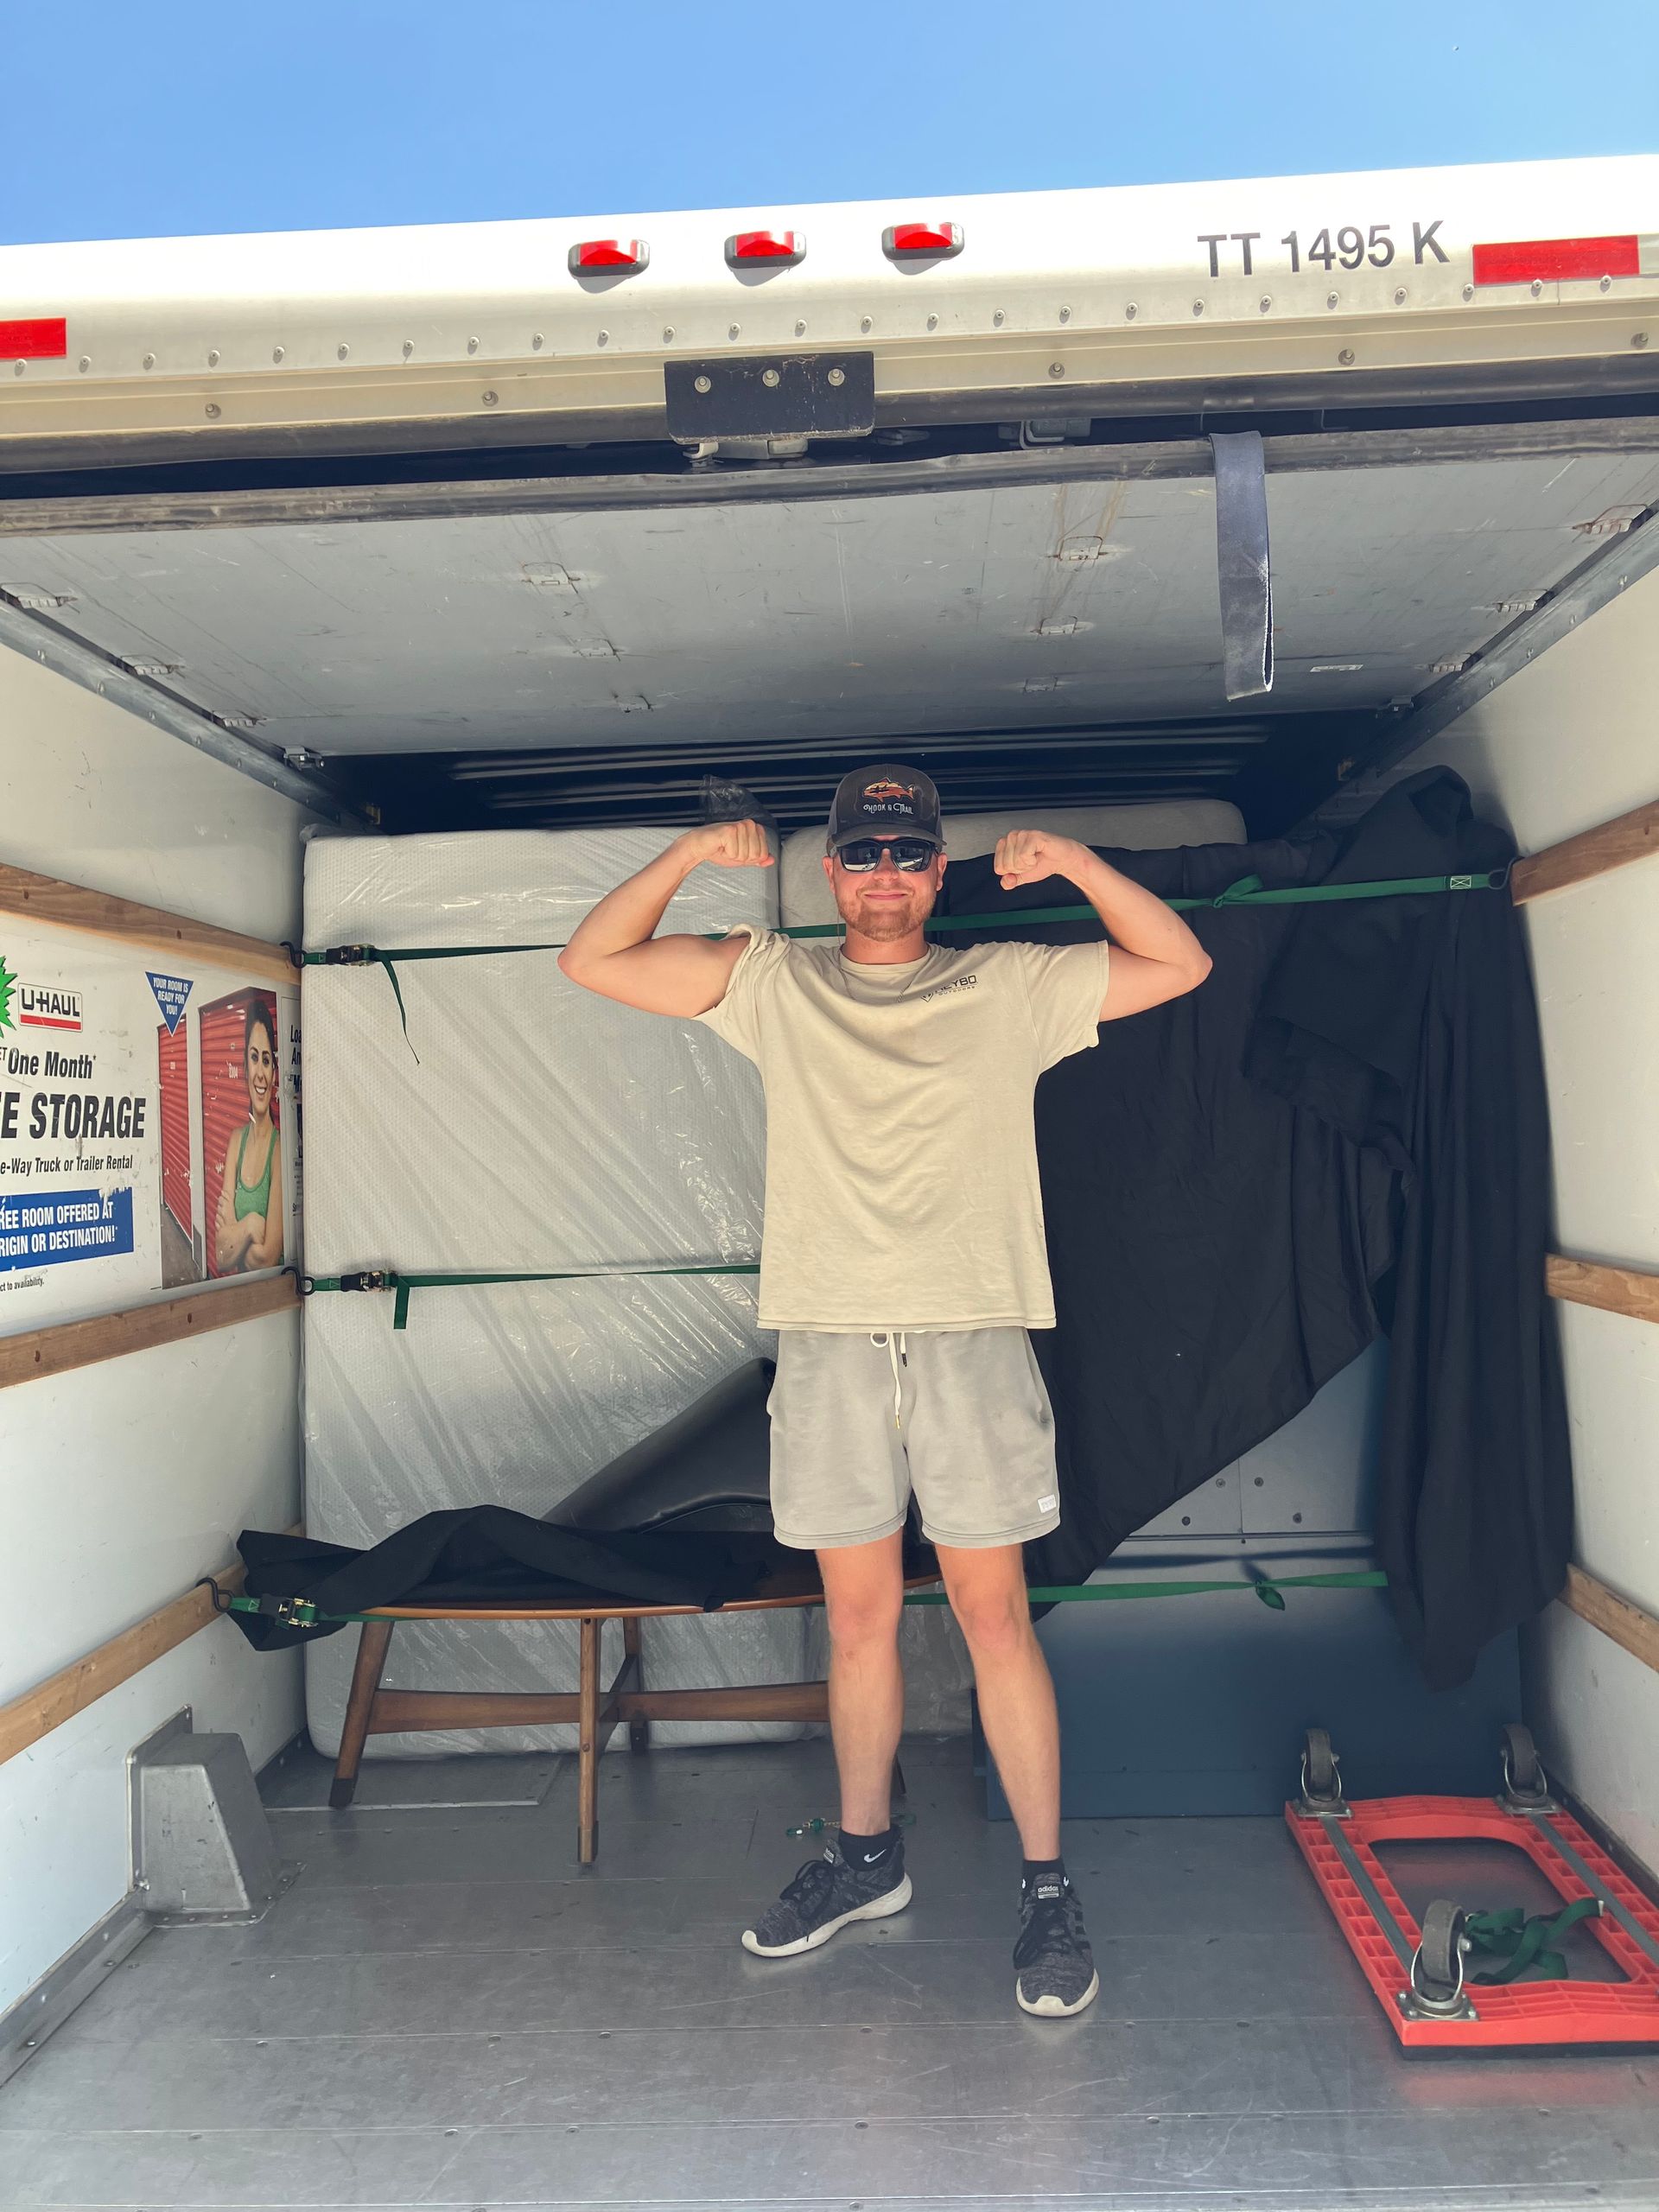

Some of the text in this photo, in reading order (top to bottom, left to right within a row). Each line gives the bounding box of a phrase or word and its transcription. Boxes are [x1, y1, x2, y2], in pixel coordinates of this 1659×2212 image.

[1197, 219, 1451, 278] TT 1495 K
[21, 988, 80, 1017] U-HAUL
[175, 994, 185, 1004] FOR
[8, 1047, 40, 1077] One
[29, 1092, 147, 1140] STORAGE
[35, 1156, 60, 1173] Truck
[64, 1159, 74, 1172] or
[76, 1154, 105, 1172] Trailer
[106, 1154, 133, 1169] Rental
[22, 1206, 54, 1228] ROOM
[57, 1202, 100, 1224] OFFERED
[102, 1201, 114, 1219] AT
[31, 1233, 47, 1253] OR
[7, 1281, 13, 1291] to
